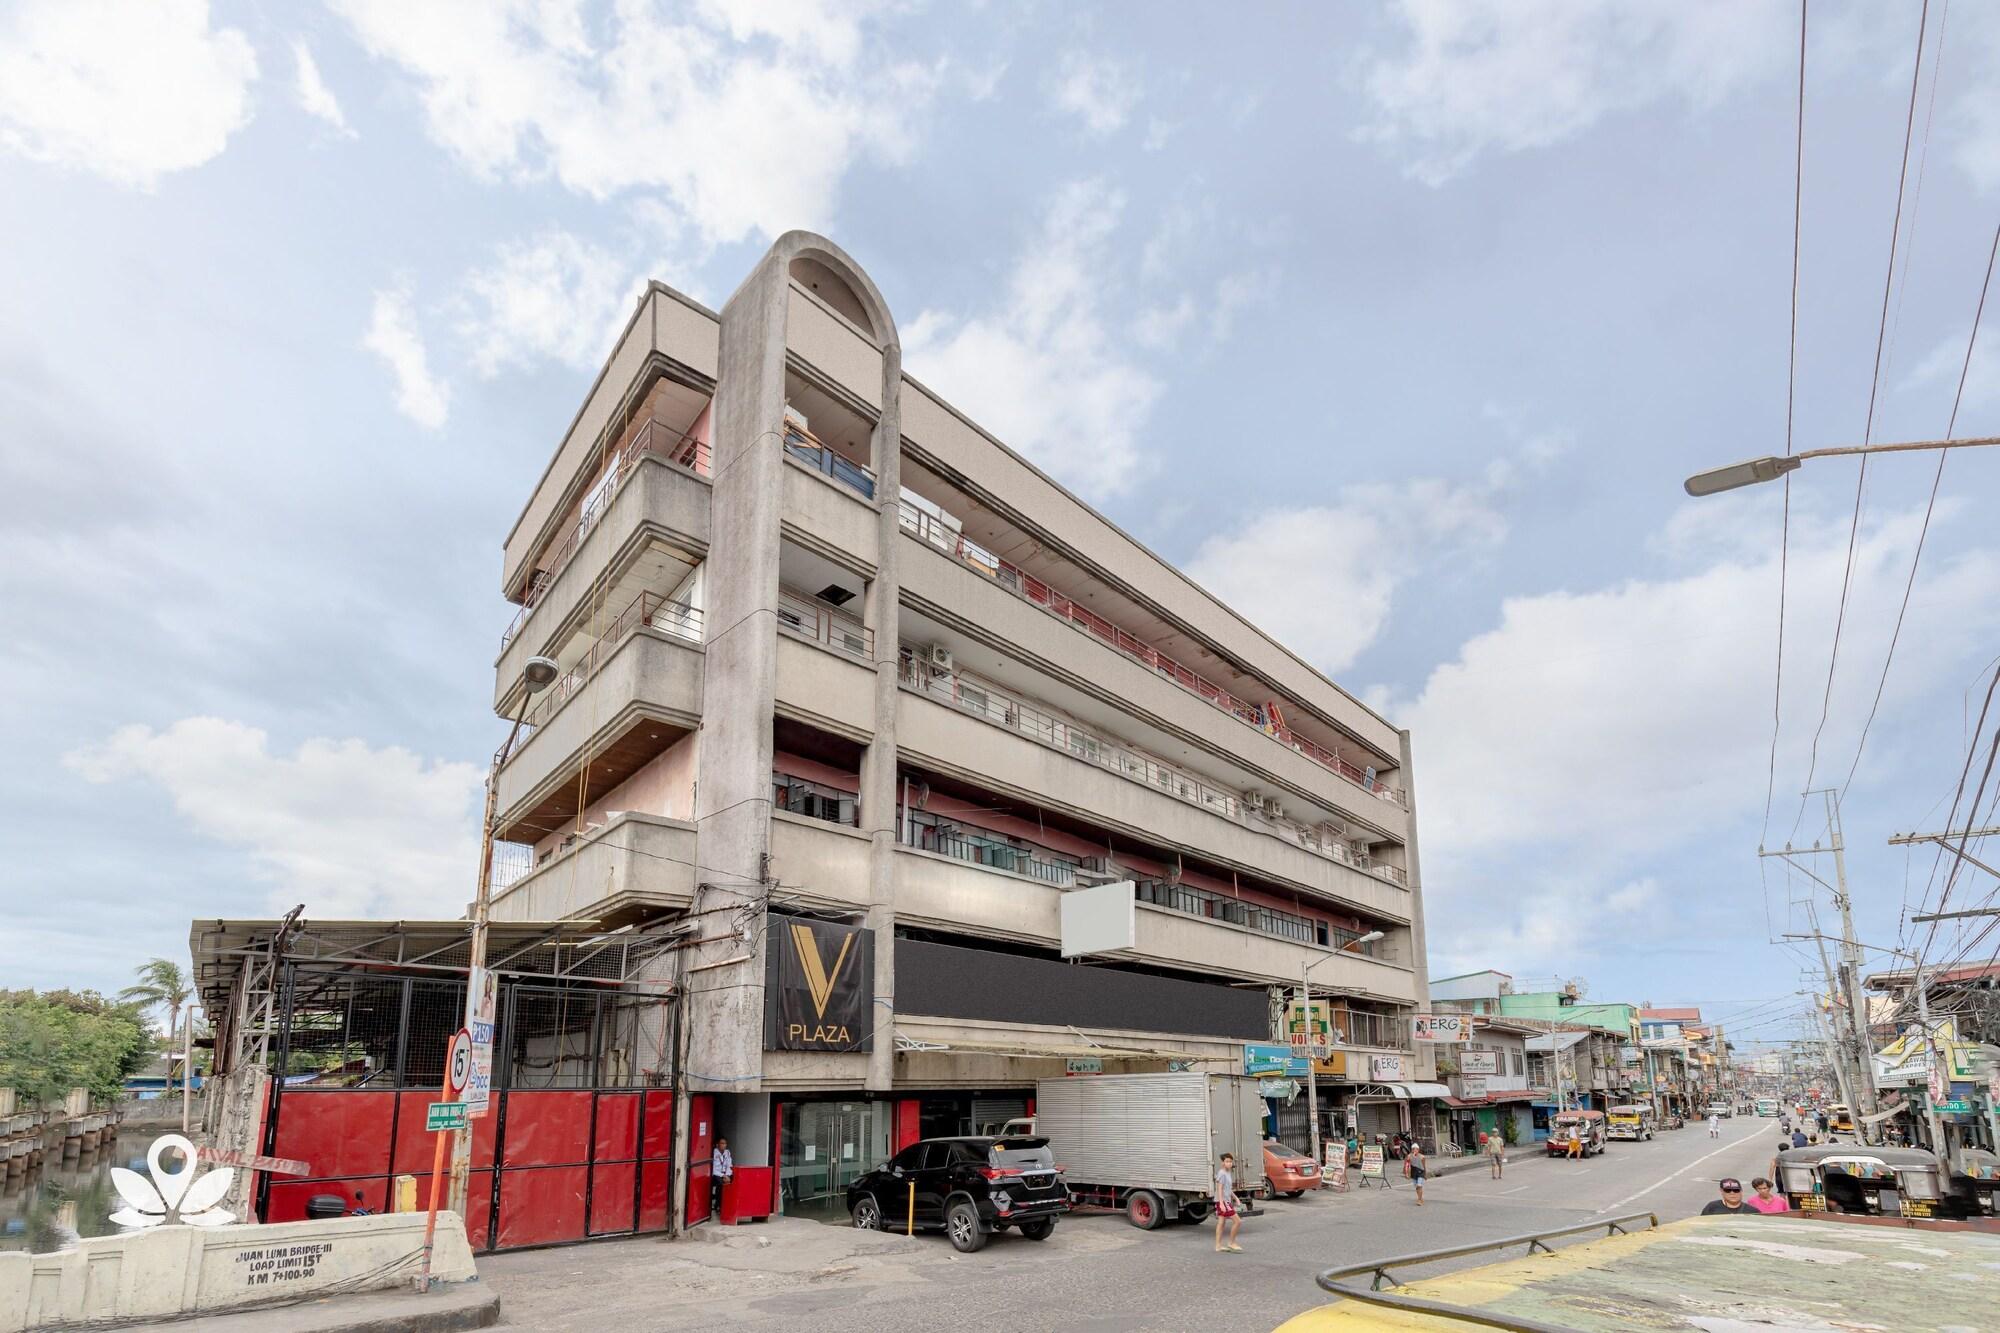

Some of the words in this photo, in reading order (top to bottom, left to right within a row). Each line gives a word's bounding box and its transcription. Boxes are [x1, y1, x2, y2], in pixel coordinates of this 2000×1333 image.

[791, 924, 853, 1020] V
[790, 1024, 850, 1043] PLAZA
[1382, 1058, 1399, 1070] ERG
[235, 1250, 263, 1263] JUAN
[266, 1247, 288, 1259] LUNA
[250, 1260, 274, 1272] LOAD
[277, 1256, 302, 1269] LIMIT
